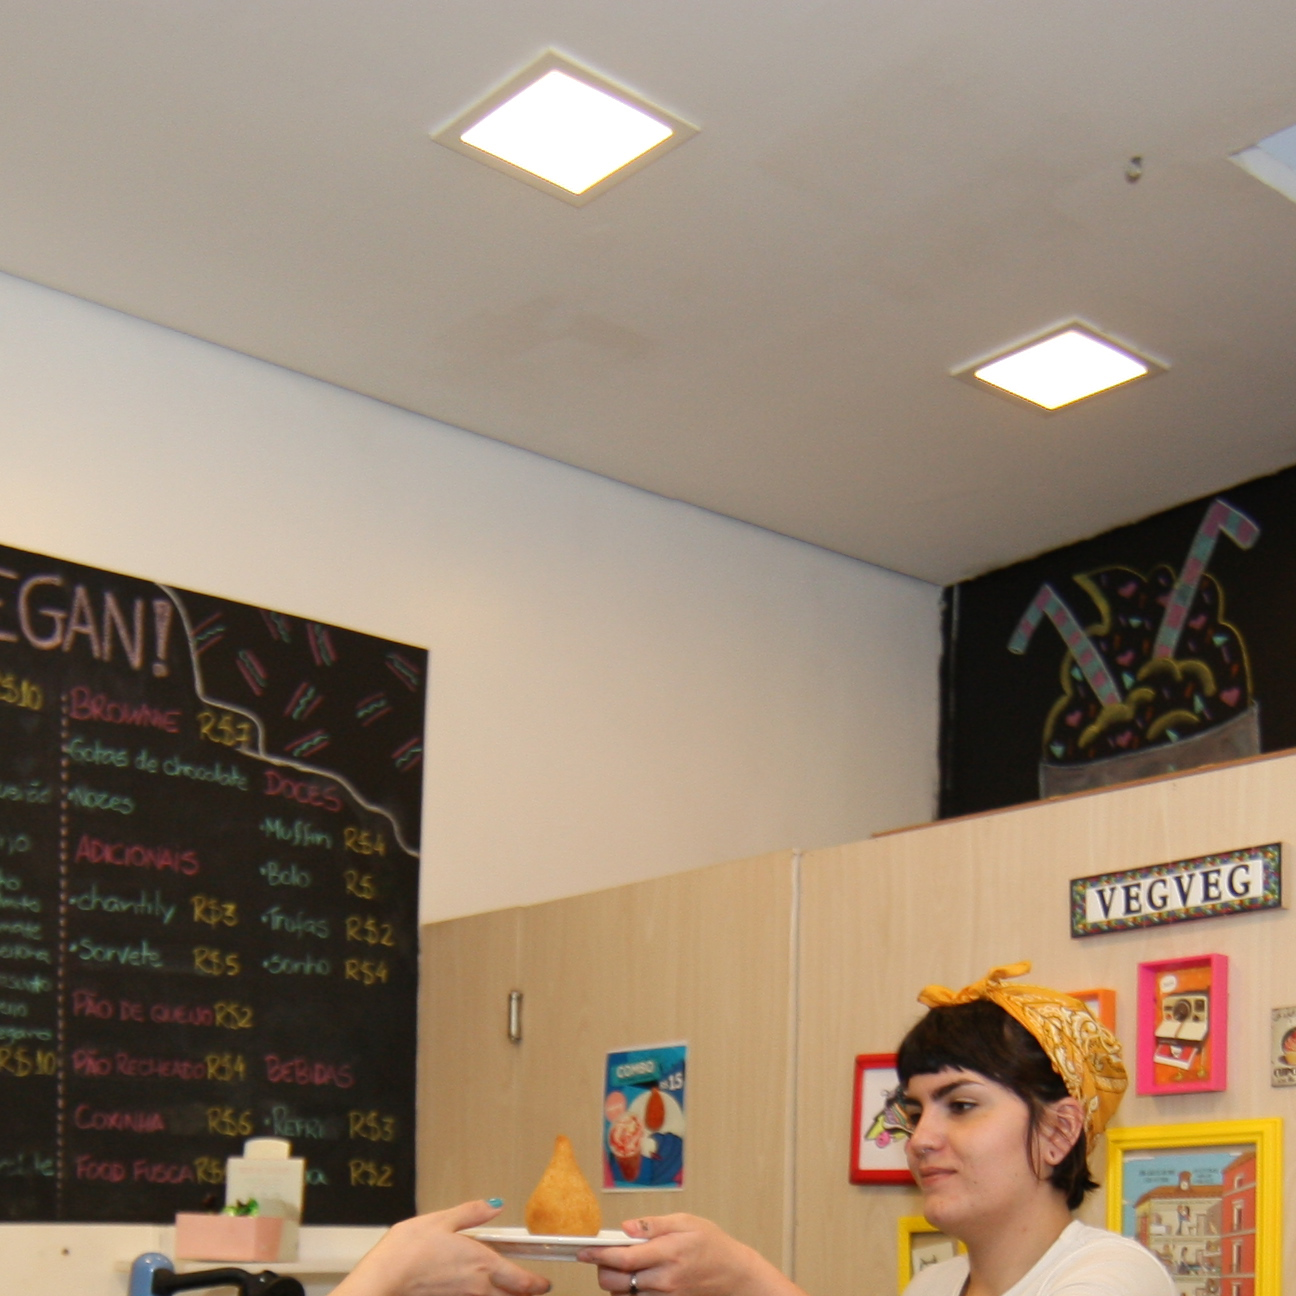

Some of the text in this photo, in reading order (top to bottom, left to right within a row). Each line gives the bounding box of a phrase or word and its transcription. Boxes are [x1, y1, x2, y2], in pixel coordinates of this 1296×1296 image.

[135, 749, 159, 775] de
[162, 757, 250, 792] chocolate
[264, 769, 344, 813] DOCES
[74, 832, 201, 878] ADICIONAIS
[1094, 862, 1253, 920] VEGVEG
[190, 892, 240, 931] R$3
[265, 903, 396, 947] Trufas R$2
[77, 936, 242, 978] Sorvete R$5
[344, 958, 390, 986] R$4
[71, 988, 114, 1021] PÃO
[119, 1000, 145, 1025] DE
[213, 1000, 254, 1031] R$2
[71, 1048, 112, 1078] PÃO
[116, 1051, 206, 1081] RECHEADO
[265, 1053, 355, 1090] BEBIDAS
[74, 1102, 255, 1138] COXINHA R$6
[271, 1104, 397, 1143] REFRI R$3
[74, 1154, 128, 1185] FOOD
[132, 1157, 195, 1186] FUSCA
[348, 1158, 394, 1188] R$2
